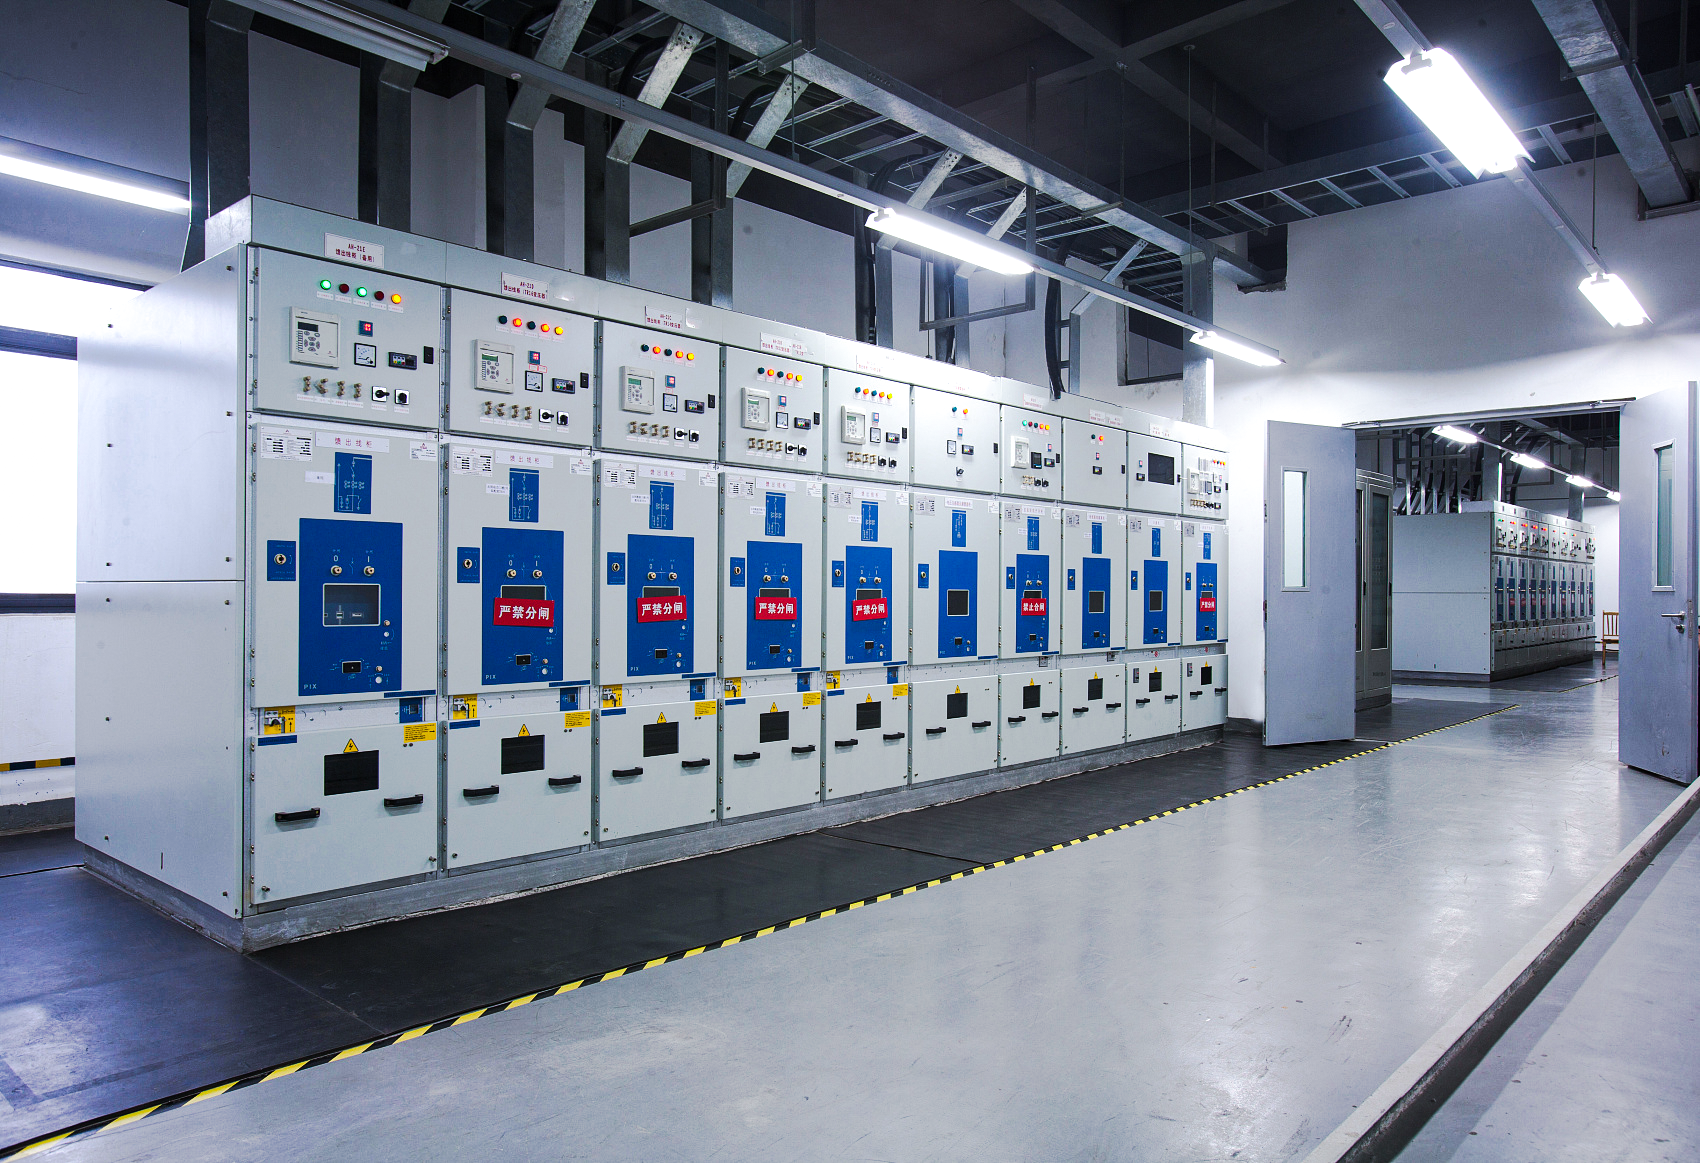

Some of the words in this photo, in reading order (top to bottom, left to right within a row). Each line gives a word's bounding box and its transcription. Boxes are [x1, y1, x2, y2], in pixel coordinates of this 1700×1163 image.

[334, 436, 373, 449] 馈出线柜
[498, 604, 550, 621] 严禁分闸
[641, 601, 684, 617] 严禁分闸
[758, 602, 795, 615] 严禁分闸
[855, 602, 886, 616] 严禁分闸
[1022, 602, 1046, 612] 禁止合闸
